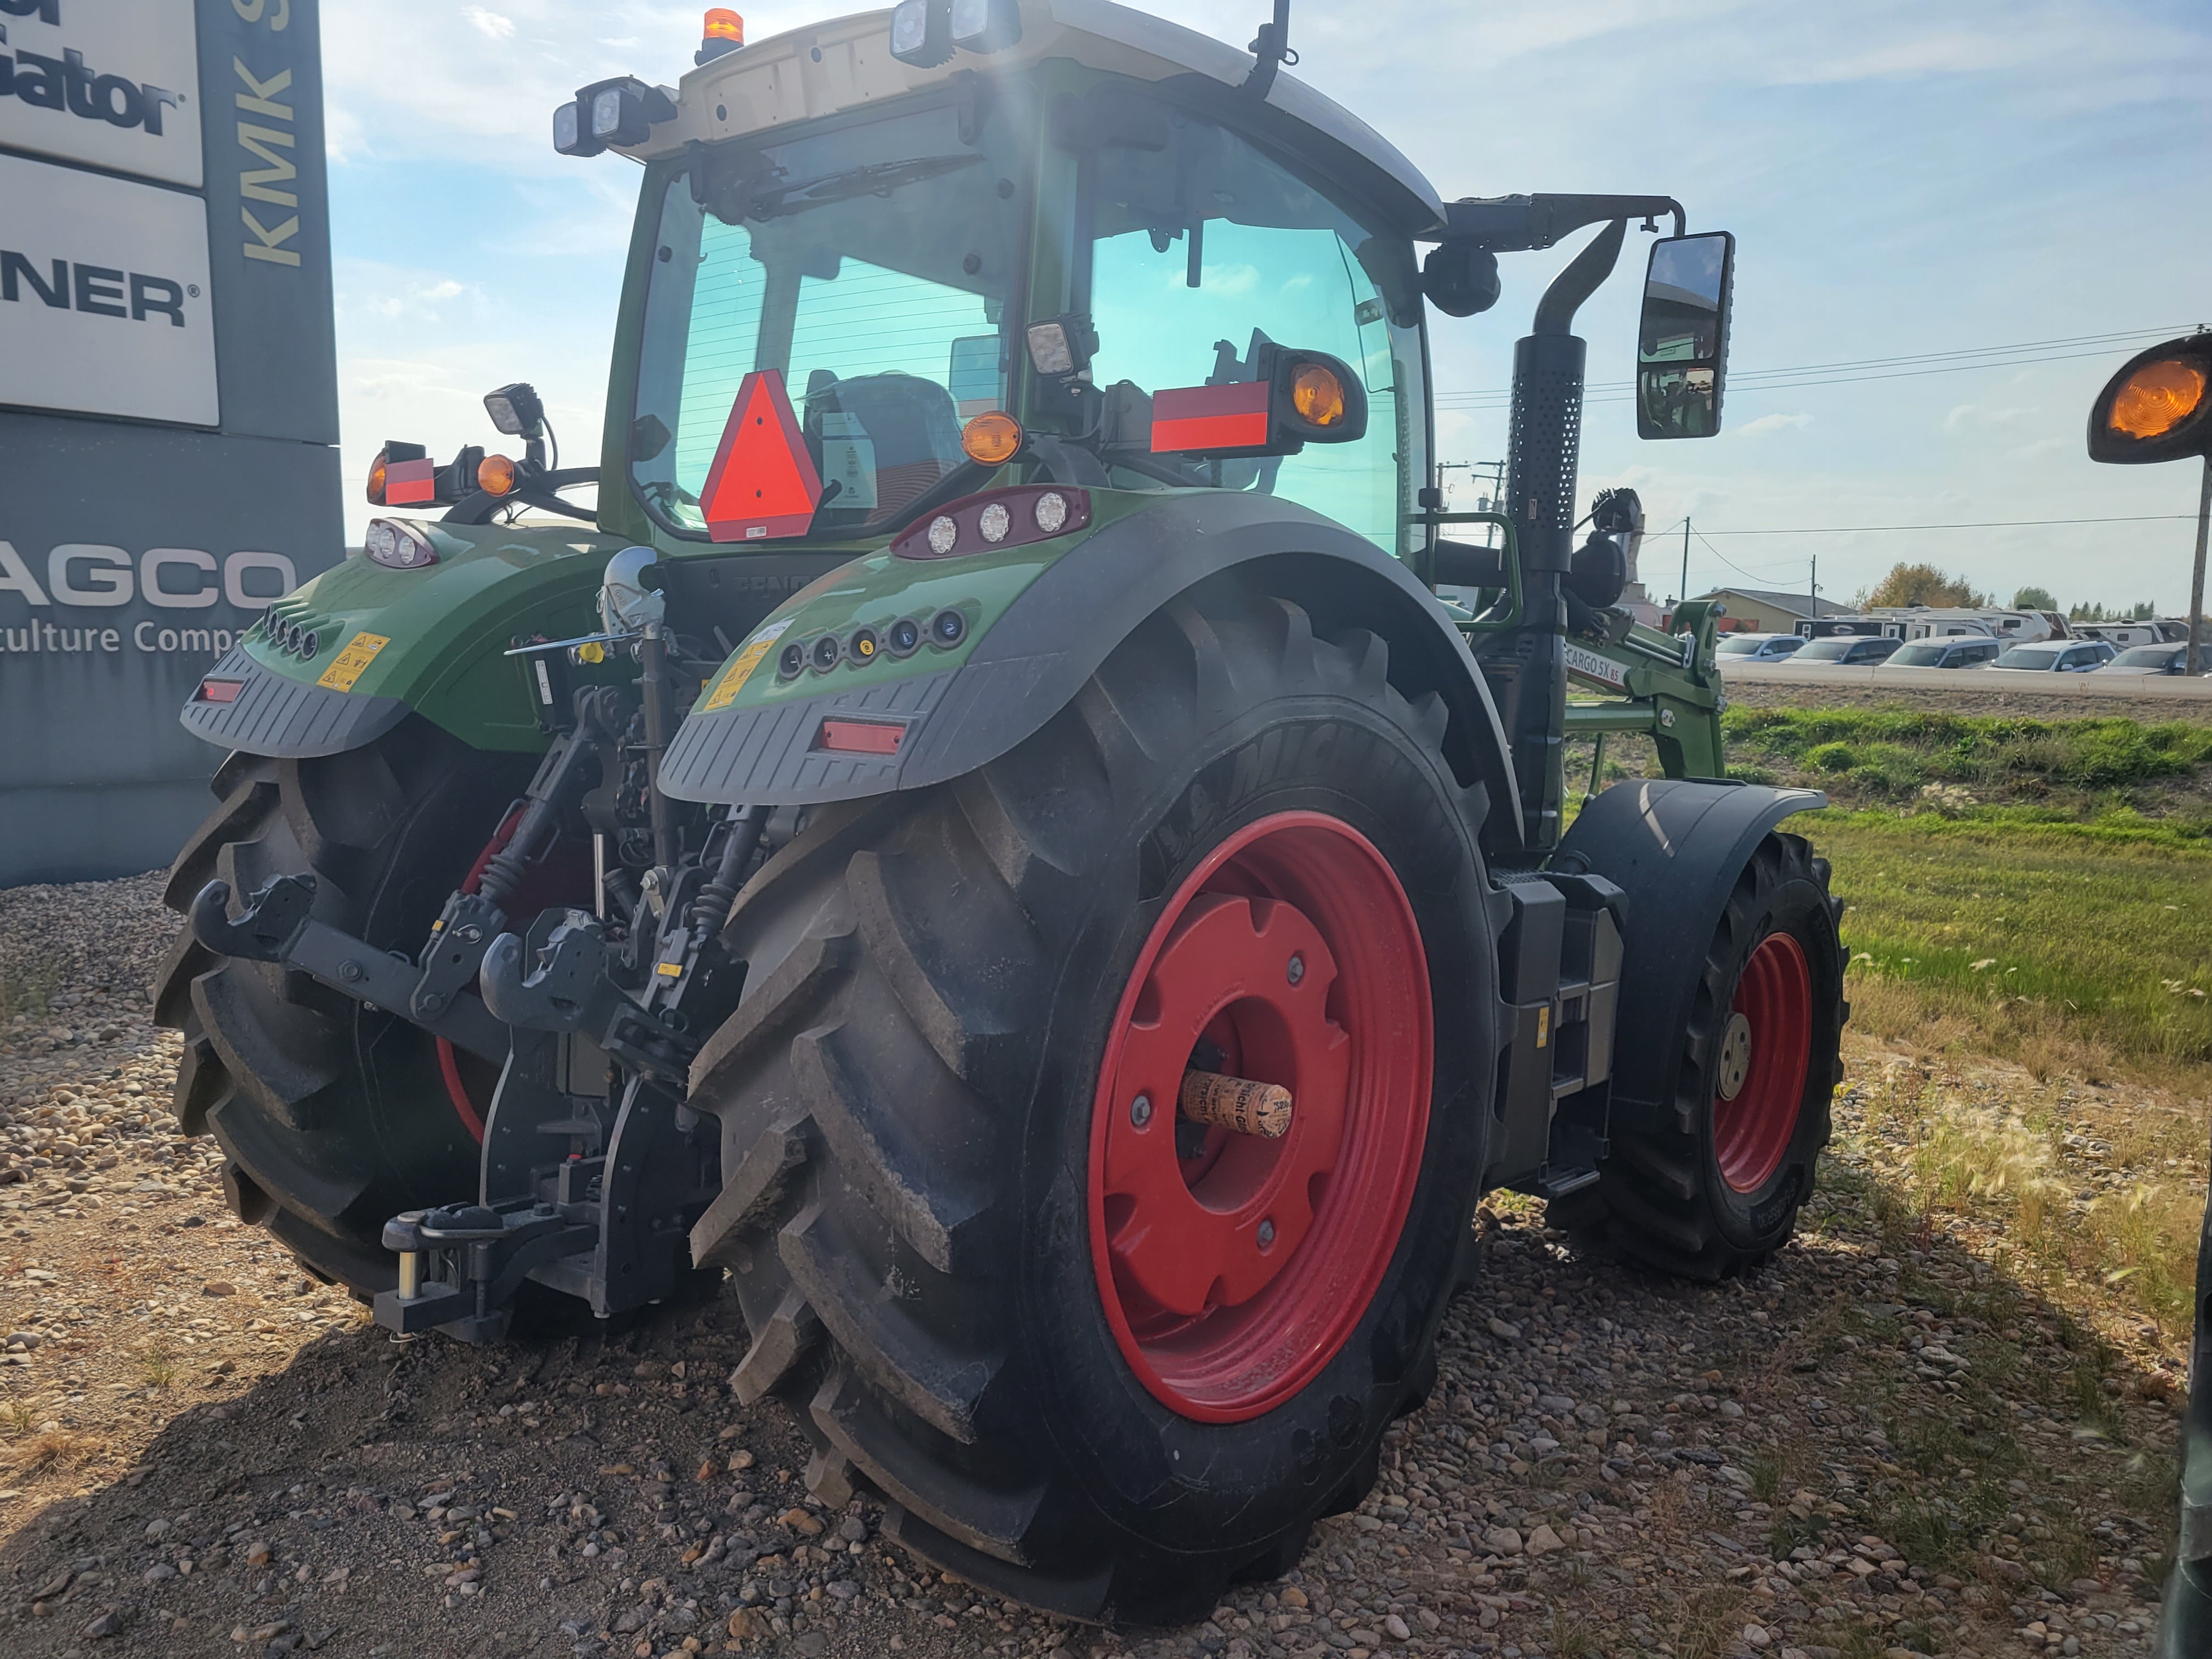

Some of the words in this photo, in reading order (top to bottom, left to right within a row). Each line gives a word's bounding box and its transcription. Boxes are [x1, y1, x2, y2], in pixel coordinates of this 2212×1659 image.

[233, 54, 301, 267] KMK
[0, 618, 120, 652] ulture
[134, 622, 249, 659] Comp
[1566, 648, 1597, 673] CARGO
[1599, 661, 1610, 679] 5X
[1611, 669, 1619, 681] 85
